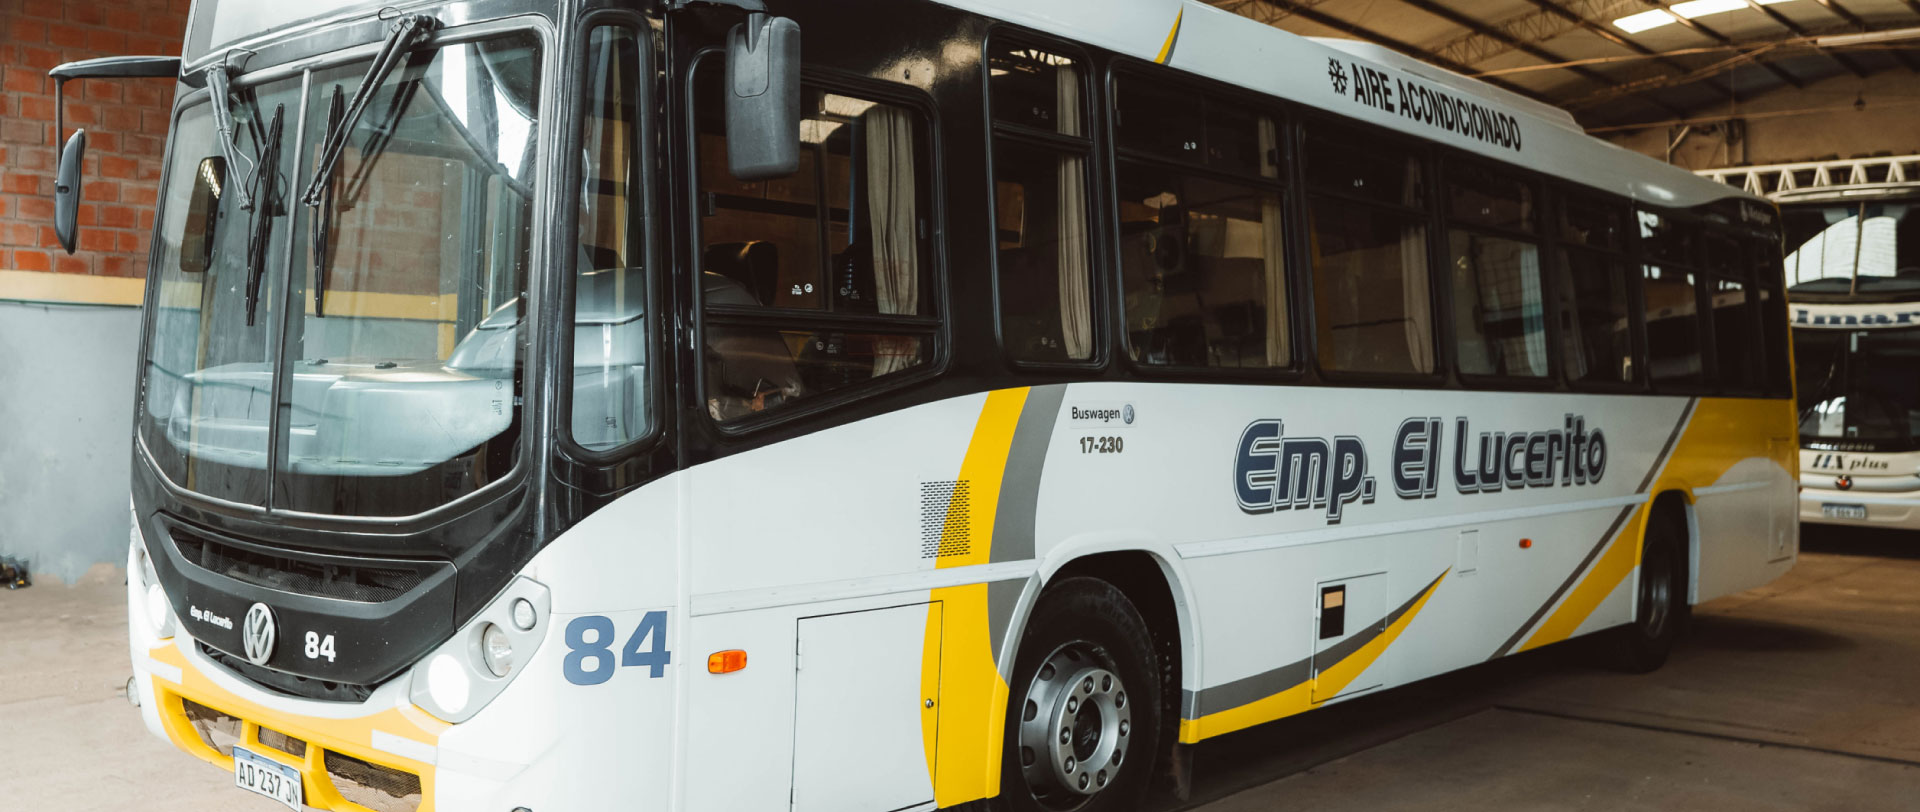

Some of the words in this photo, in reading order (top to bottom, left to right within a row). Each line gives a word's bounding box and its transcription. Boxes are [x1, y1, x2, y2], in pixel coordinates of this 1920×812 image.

[1351, 62, 1395, 113] AIRE
[1397, 77, 1522, 152] ACONDICIONADO
[1071, 406, 1121, 423] Buswagen
[1079, 436, 1124, 454] 17-230
[1849, 457, 1889, 470] plus
[1233, 418, 1375, 524] Emp.
[1392, 416, 1443, 499] El
[1454, 413, 1606, 493] Lucerito
[305, 631, 336, 663] 84
[563, 611, 671, 686] 84
[239, 761, 255, 787] AD
[258, 768, 281, 797] 237
[285, 780, 299, 808] JN
